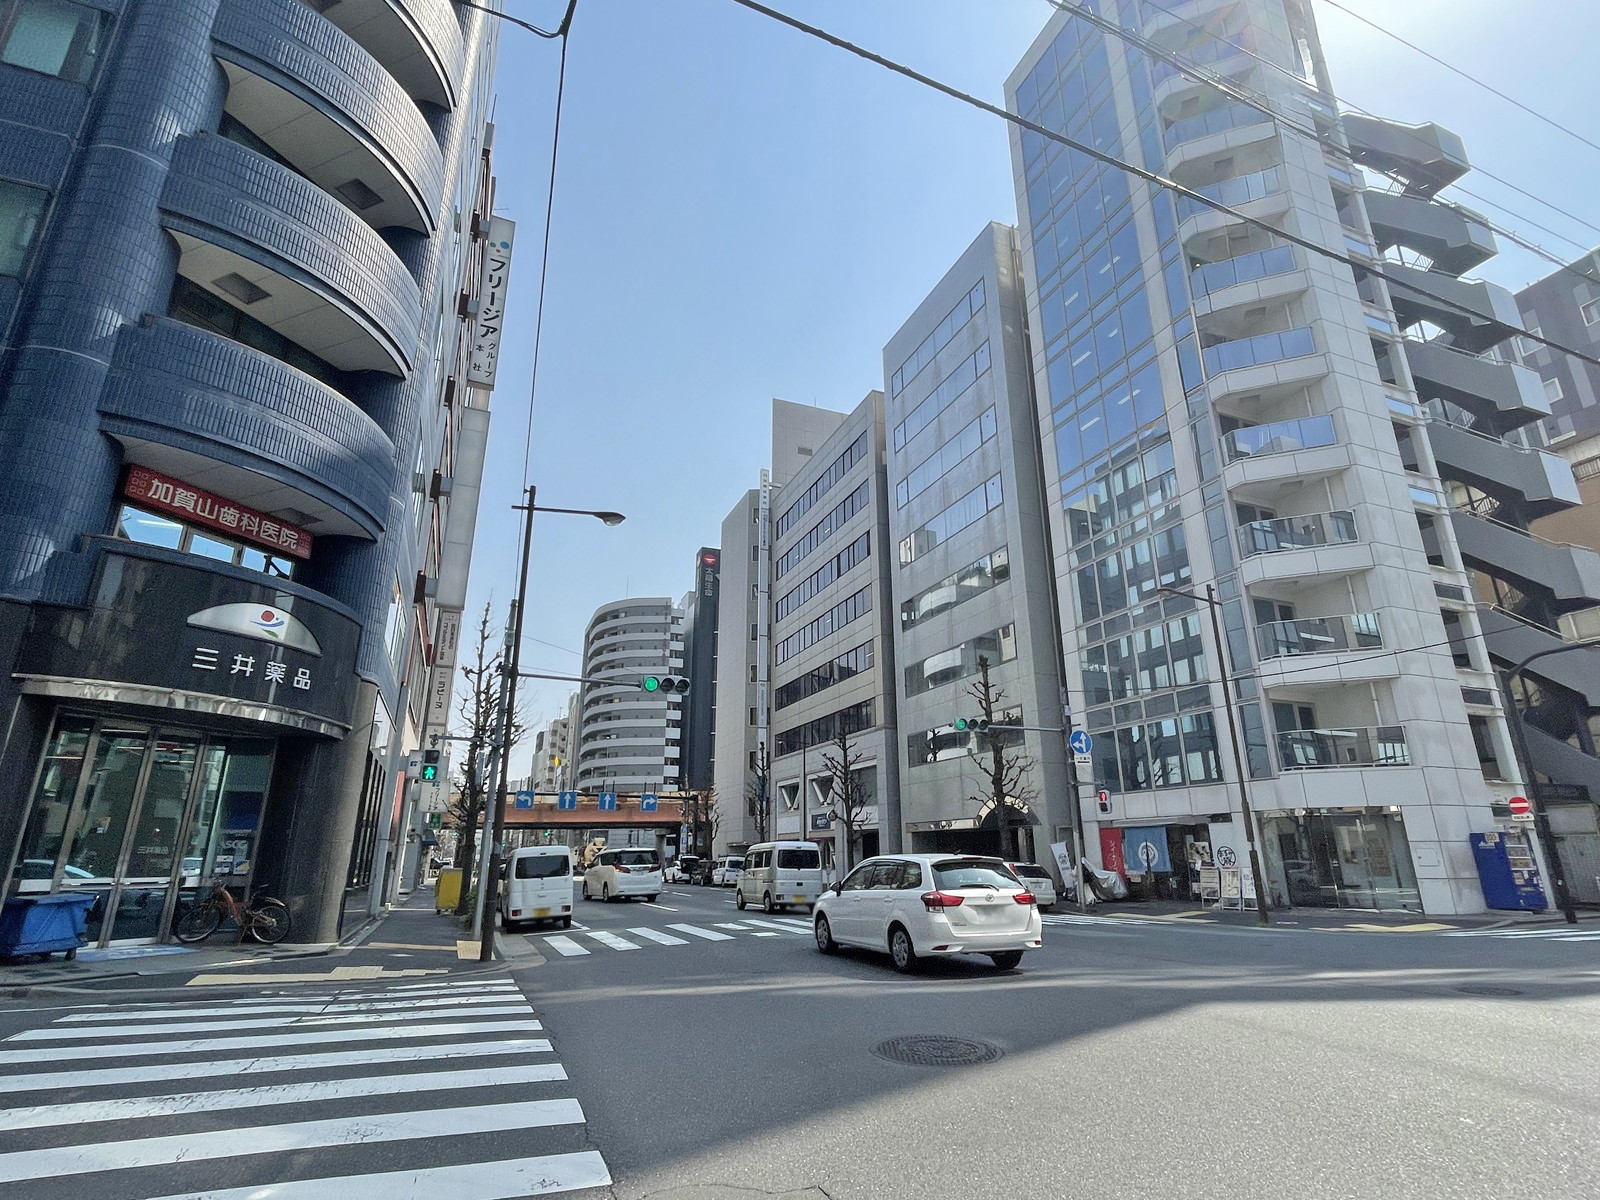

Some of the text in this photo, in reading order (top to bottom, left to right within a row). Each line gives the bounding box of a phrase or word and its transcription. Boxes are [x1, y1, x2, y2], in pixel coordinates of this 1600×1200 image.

[480, 257, 506, 338] フリージア
[484, 342, 496, 378] グループ
[147, 478, 299, 550] 加賀山歯科医院
[192, 647, 311, 690] 三井薬品
